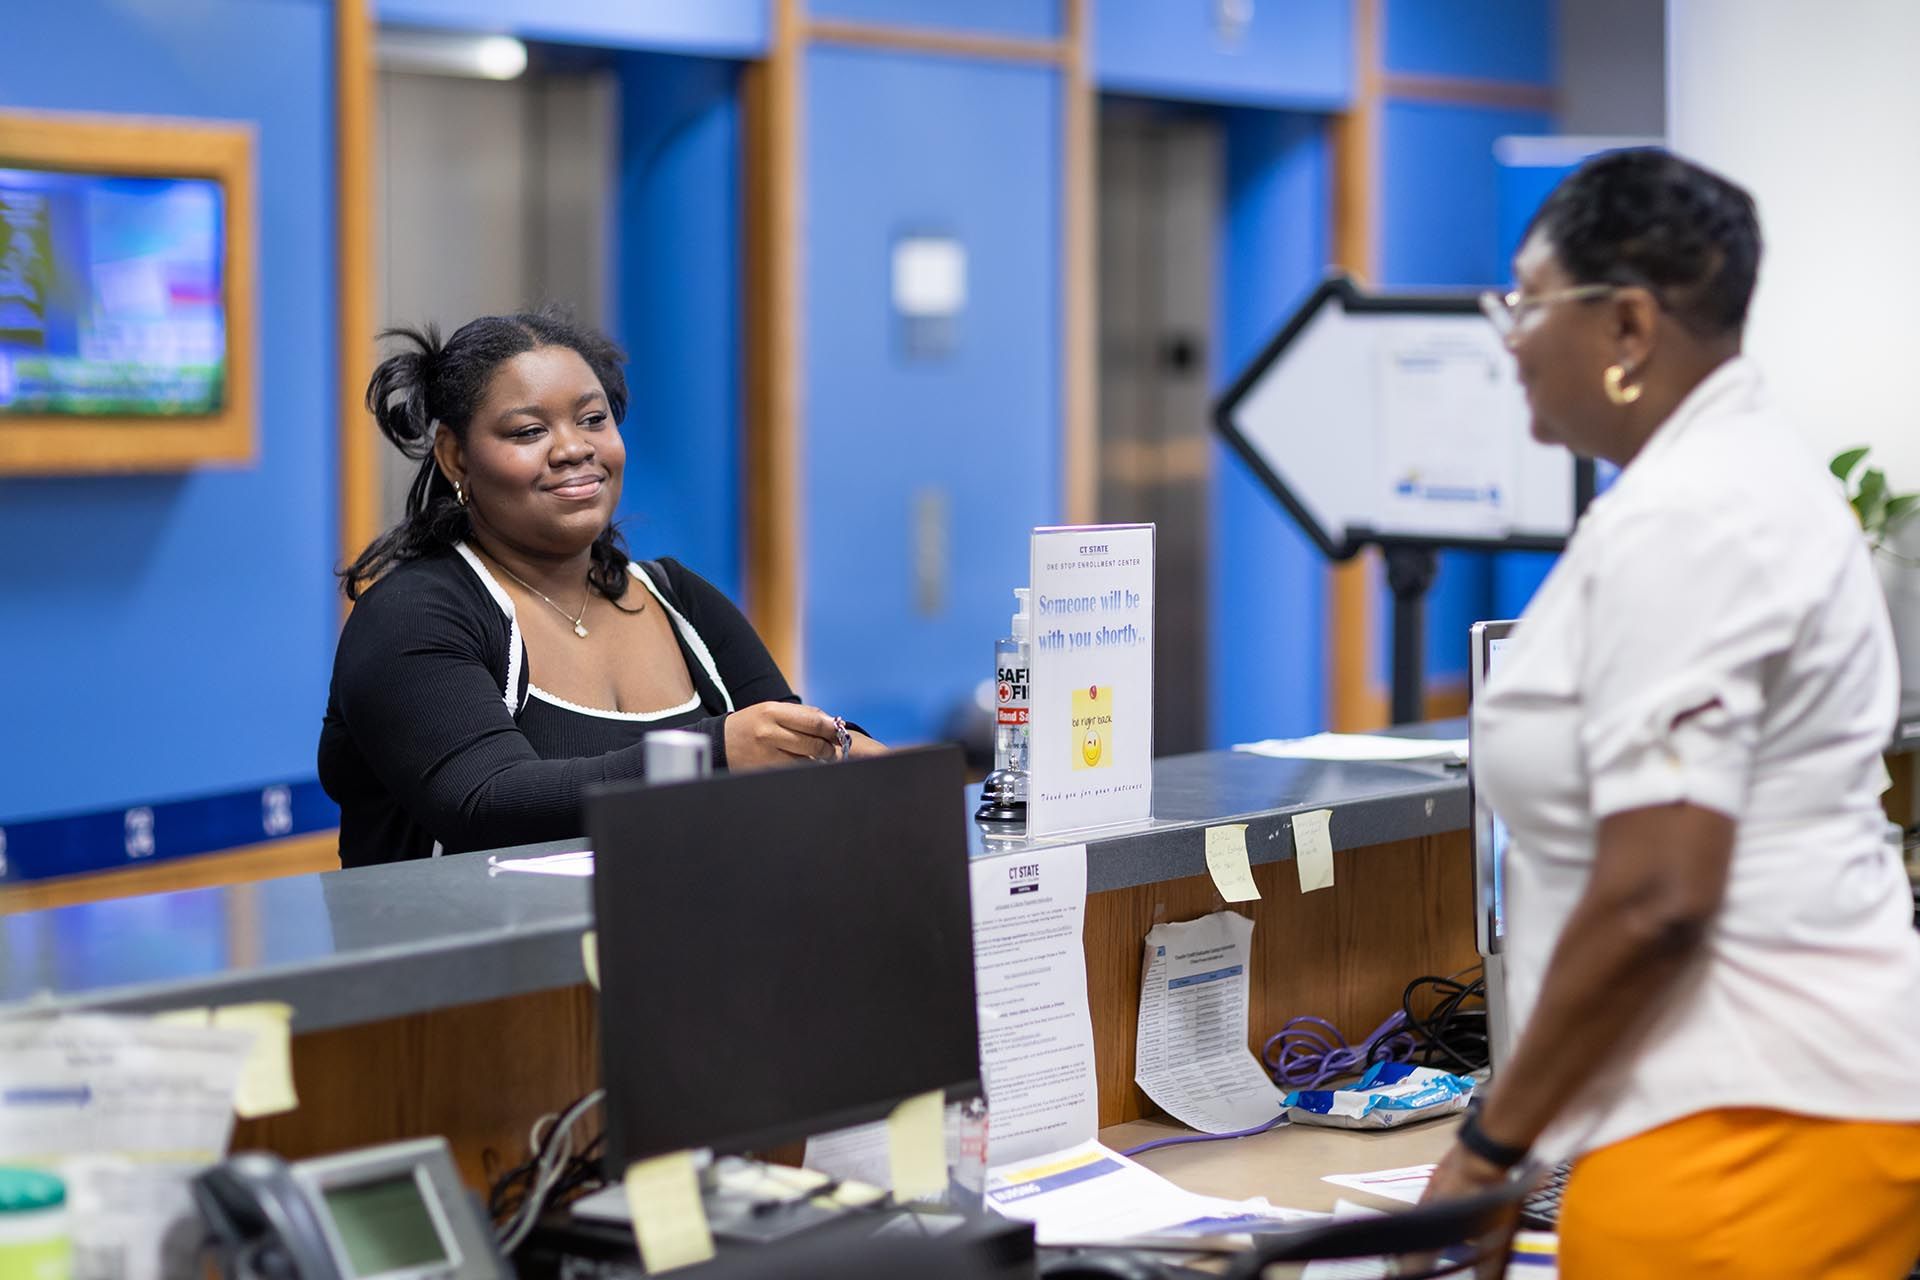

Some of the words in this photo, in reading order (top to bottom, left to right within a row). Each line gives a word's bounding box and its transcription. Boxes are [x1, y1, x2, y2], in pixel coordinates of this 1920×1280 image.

[1079, 546, 1087, 554] CT
[1089, 545, 1109, 553] STATE
[1046, 563, 1058, 571] ONE
[1060, 562, 1076, 570] STOP
[1078, 560, 1116, 569] ENROLLMENT
[1118, 558, 1141, 567] CENTER
[1039, 594, 1097, 615] Someone
[1100, 590, 1121, 611] will
[1125, 589, 1140, 609] be
[1038, 629, 1065, 650] with
[1069, 631, 1092, 652] you
[998, 668, 1030, 684] SAF
[1012, 685, 1030, 700] FI
[1081, 716, 1096, 730] right
[1097, 715, 1113, 725] back
[1040, 792, 1061, 801] Thank
[1080, 789, 1091, 799] for
[1095, 788, 1110, 797] your
[1008, 867, 1017, 880] CT
[1019, 864, 1040, 879] STATE
